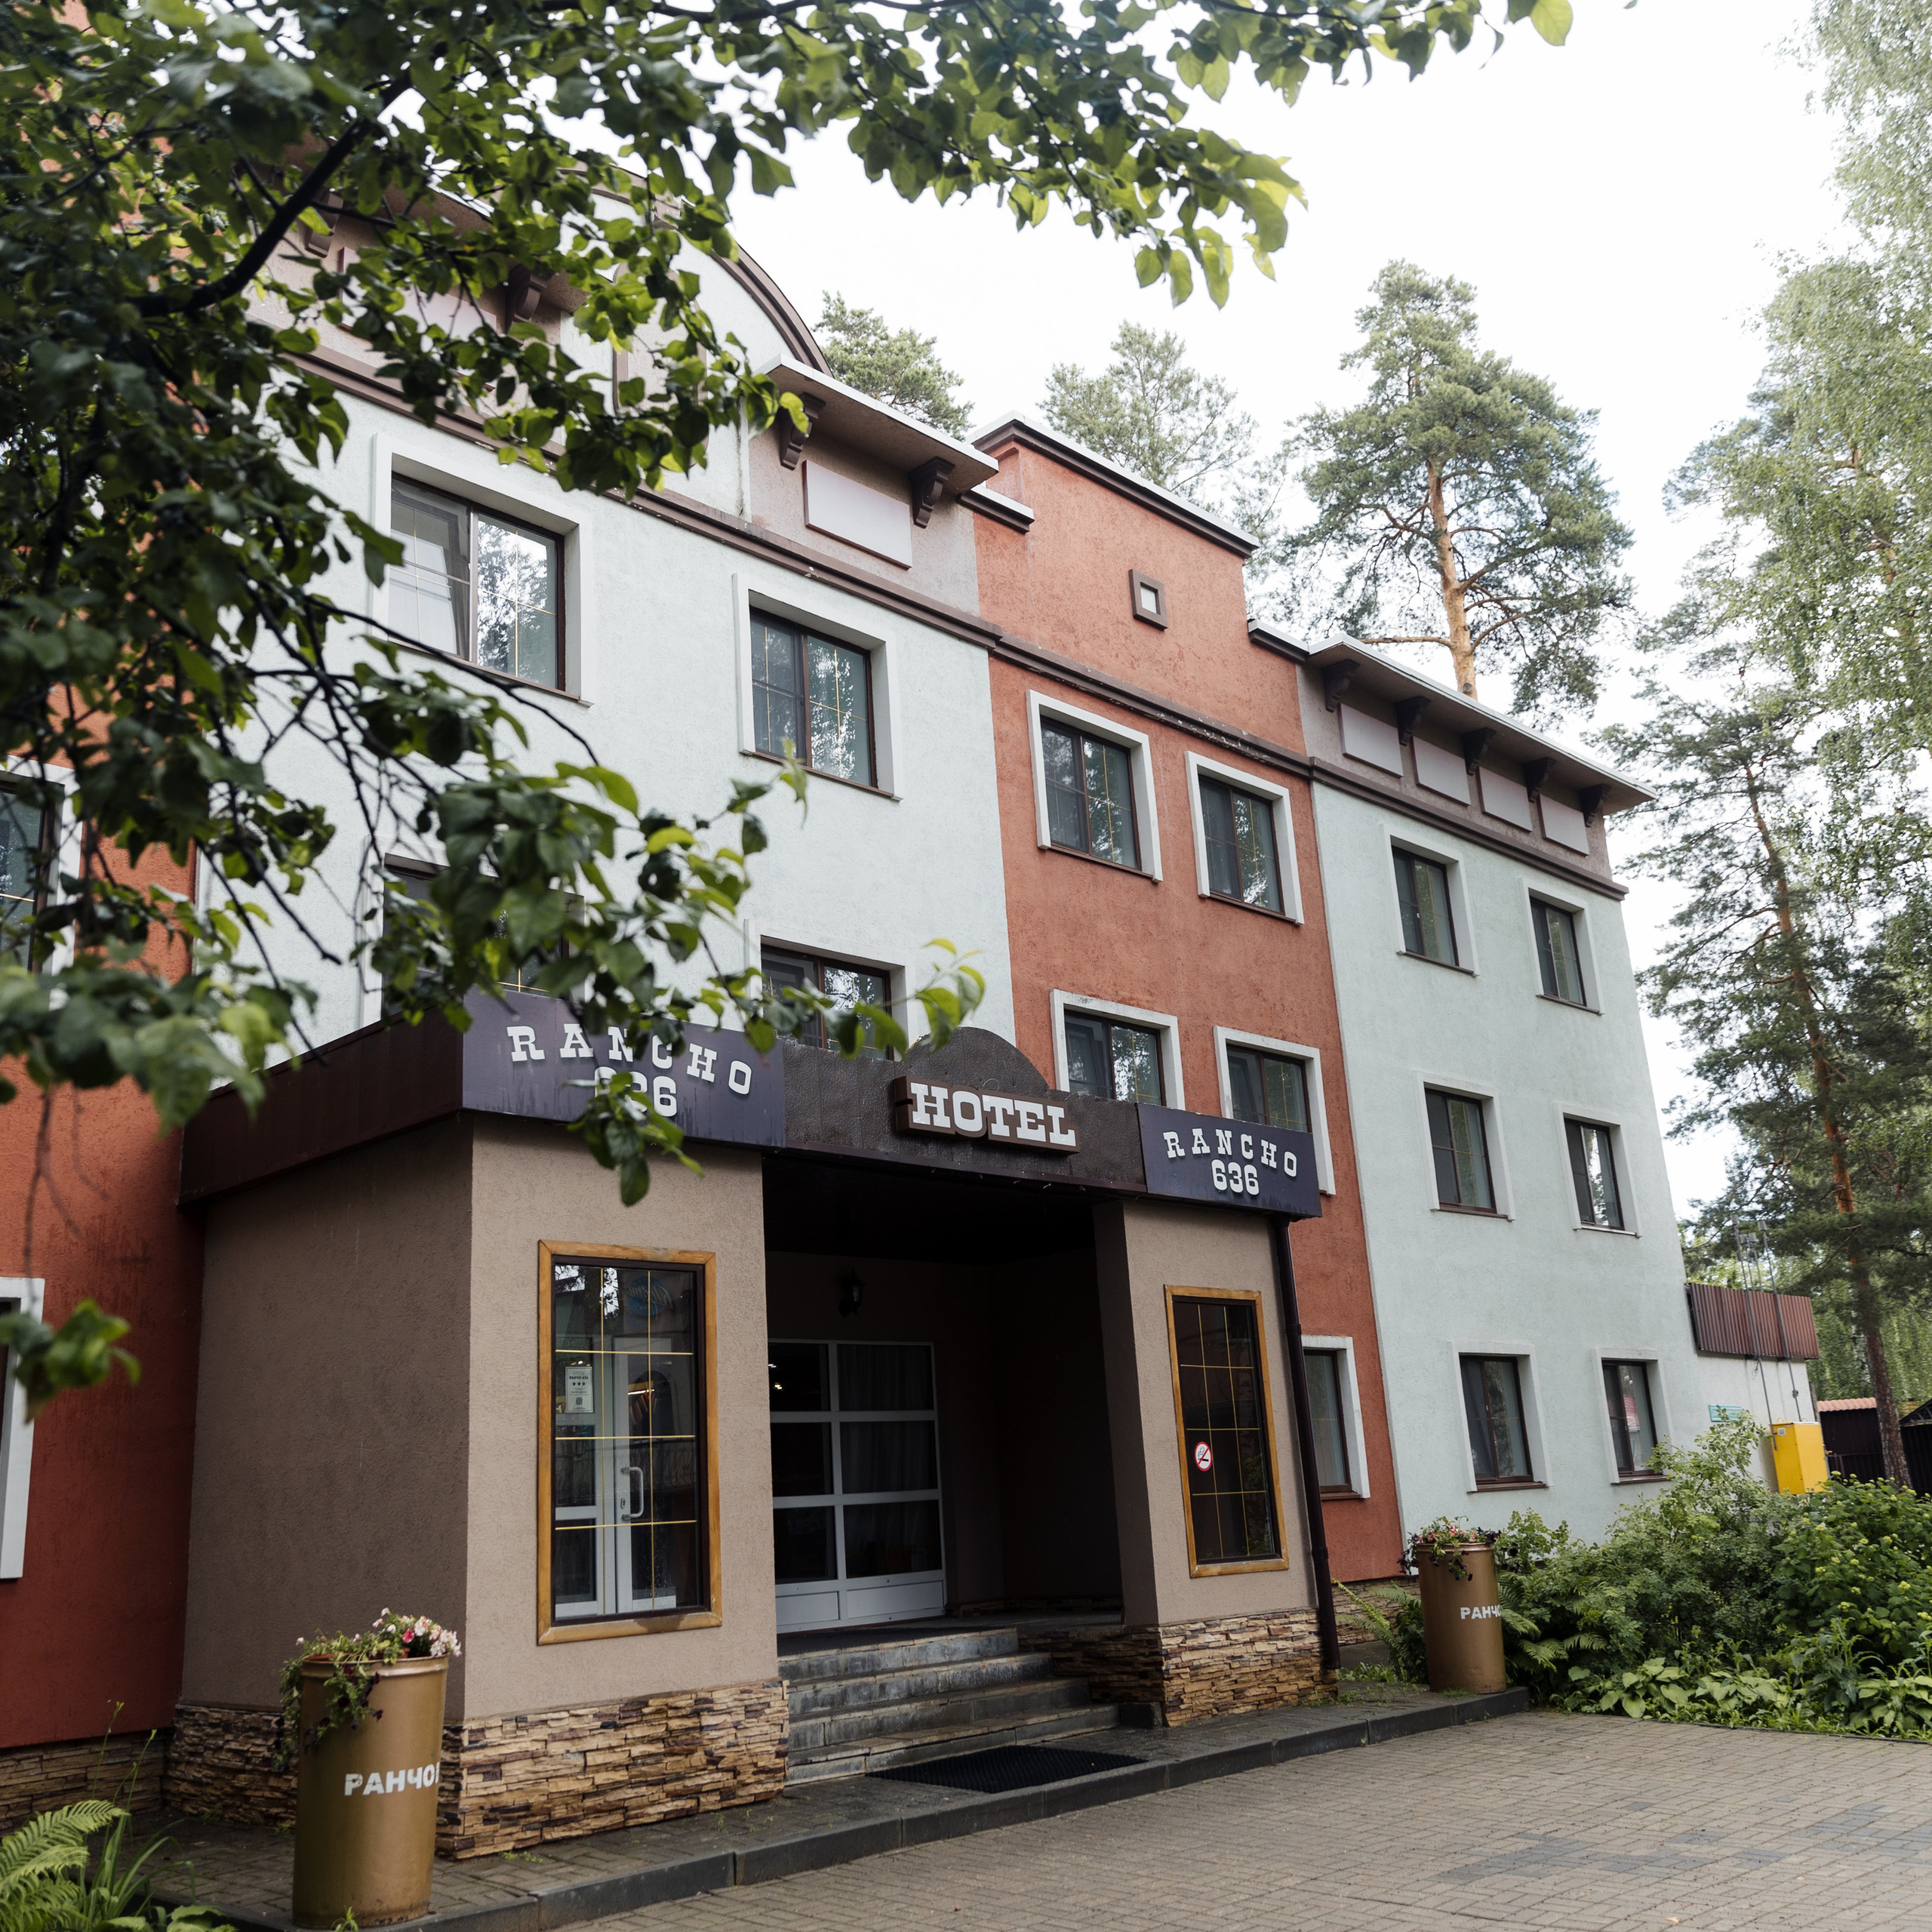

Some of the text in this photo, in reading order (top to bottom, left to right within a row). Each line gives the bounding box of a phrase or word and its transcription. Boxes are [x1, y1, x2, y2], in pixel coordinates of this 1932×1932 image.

[506, 1023, 752, 1095] RANCHO
[910, 1082, 1076, 1147] HOTEL
[1163, 1128, 1297, 1177] RANCHO
[1211, 1159, 1260, 1195] 636
